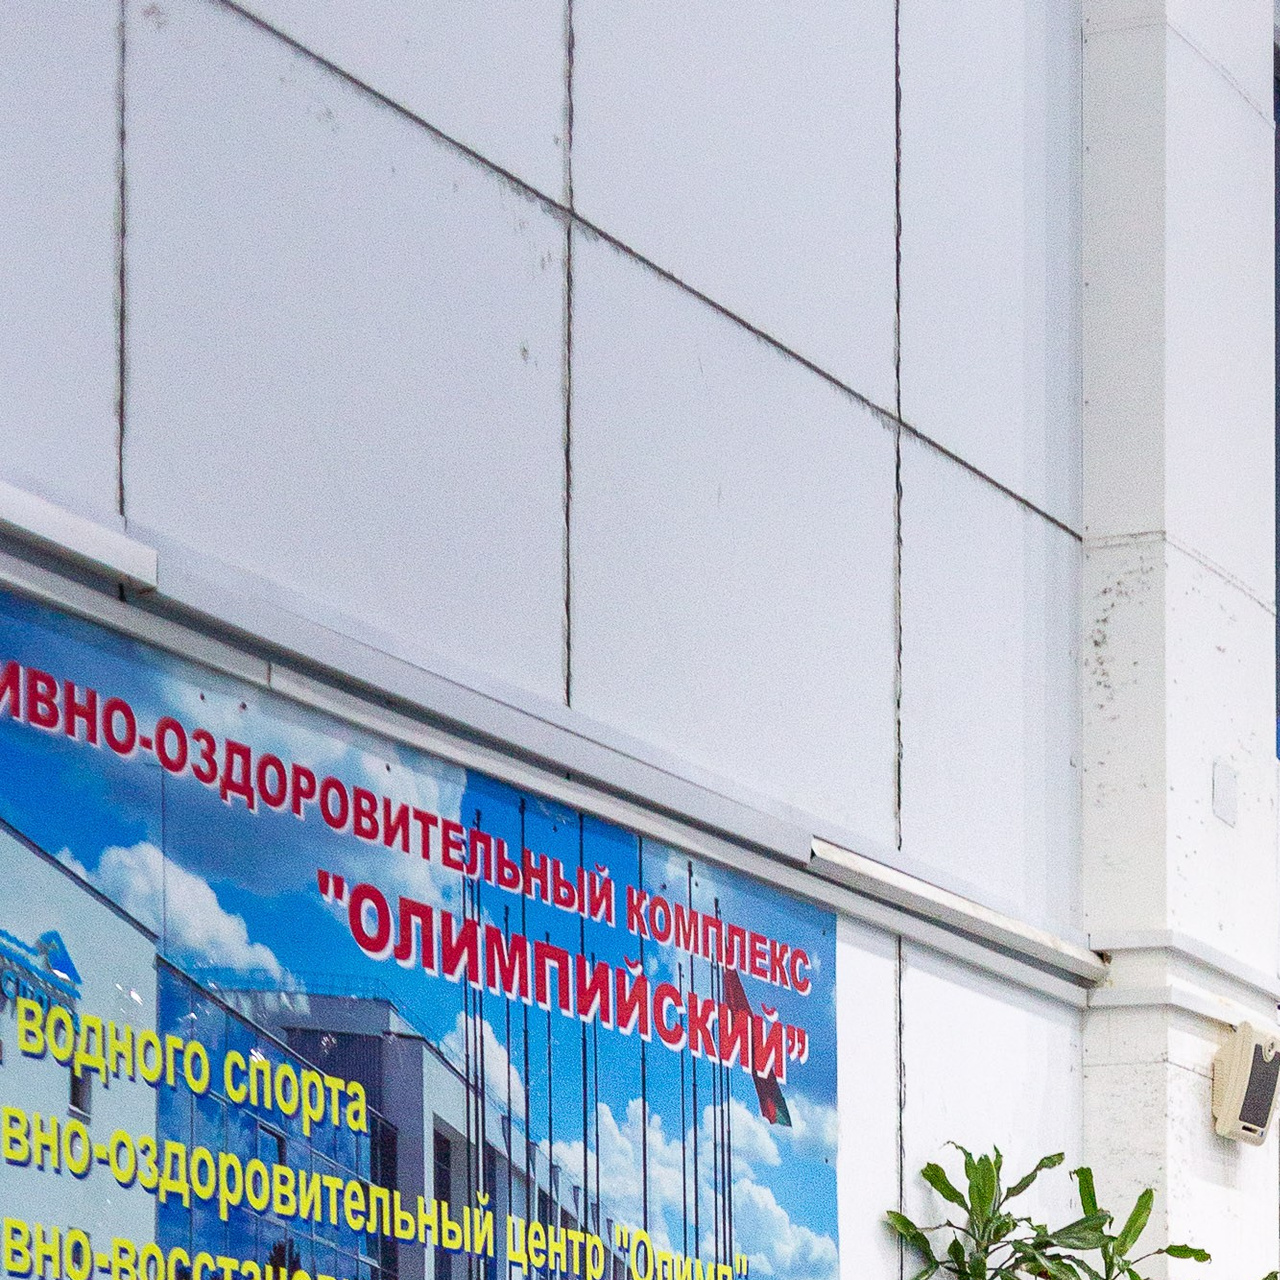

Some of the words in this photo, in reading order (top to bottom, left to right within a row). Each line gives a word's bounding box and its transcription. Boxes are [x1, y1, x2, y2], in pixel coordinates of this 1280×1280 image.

[626, 885, 813, 995] КОМПЛЕКС
[16, 995, 211, 1095] водного
[223, 1050, 370, 1137] спорта
[1, 1106, 495, 1258] вно-оздоровительный
